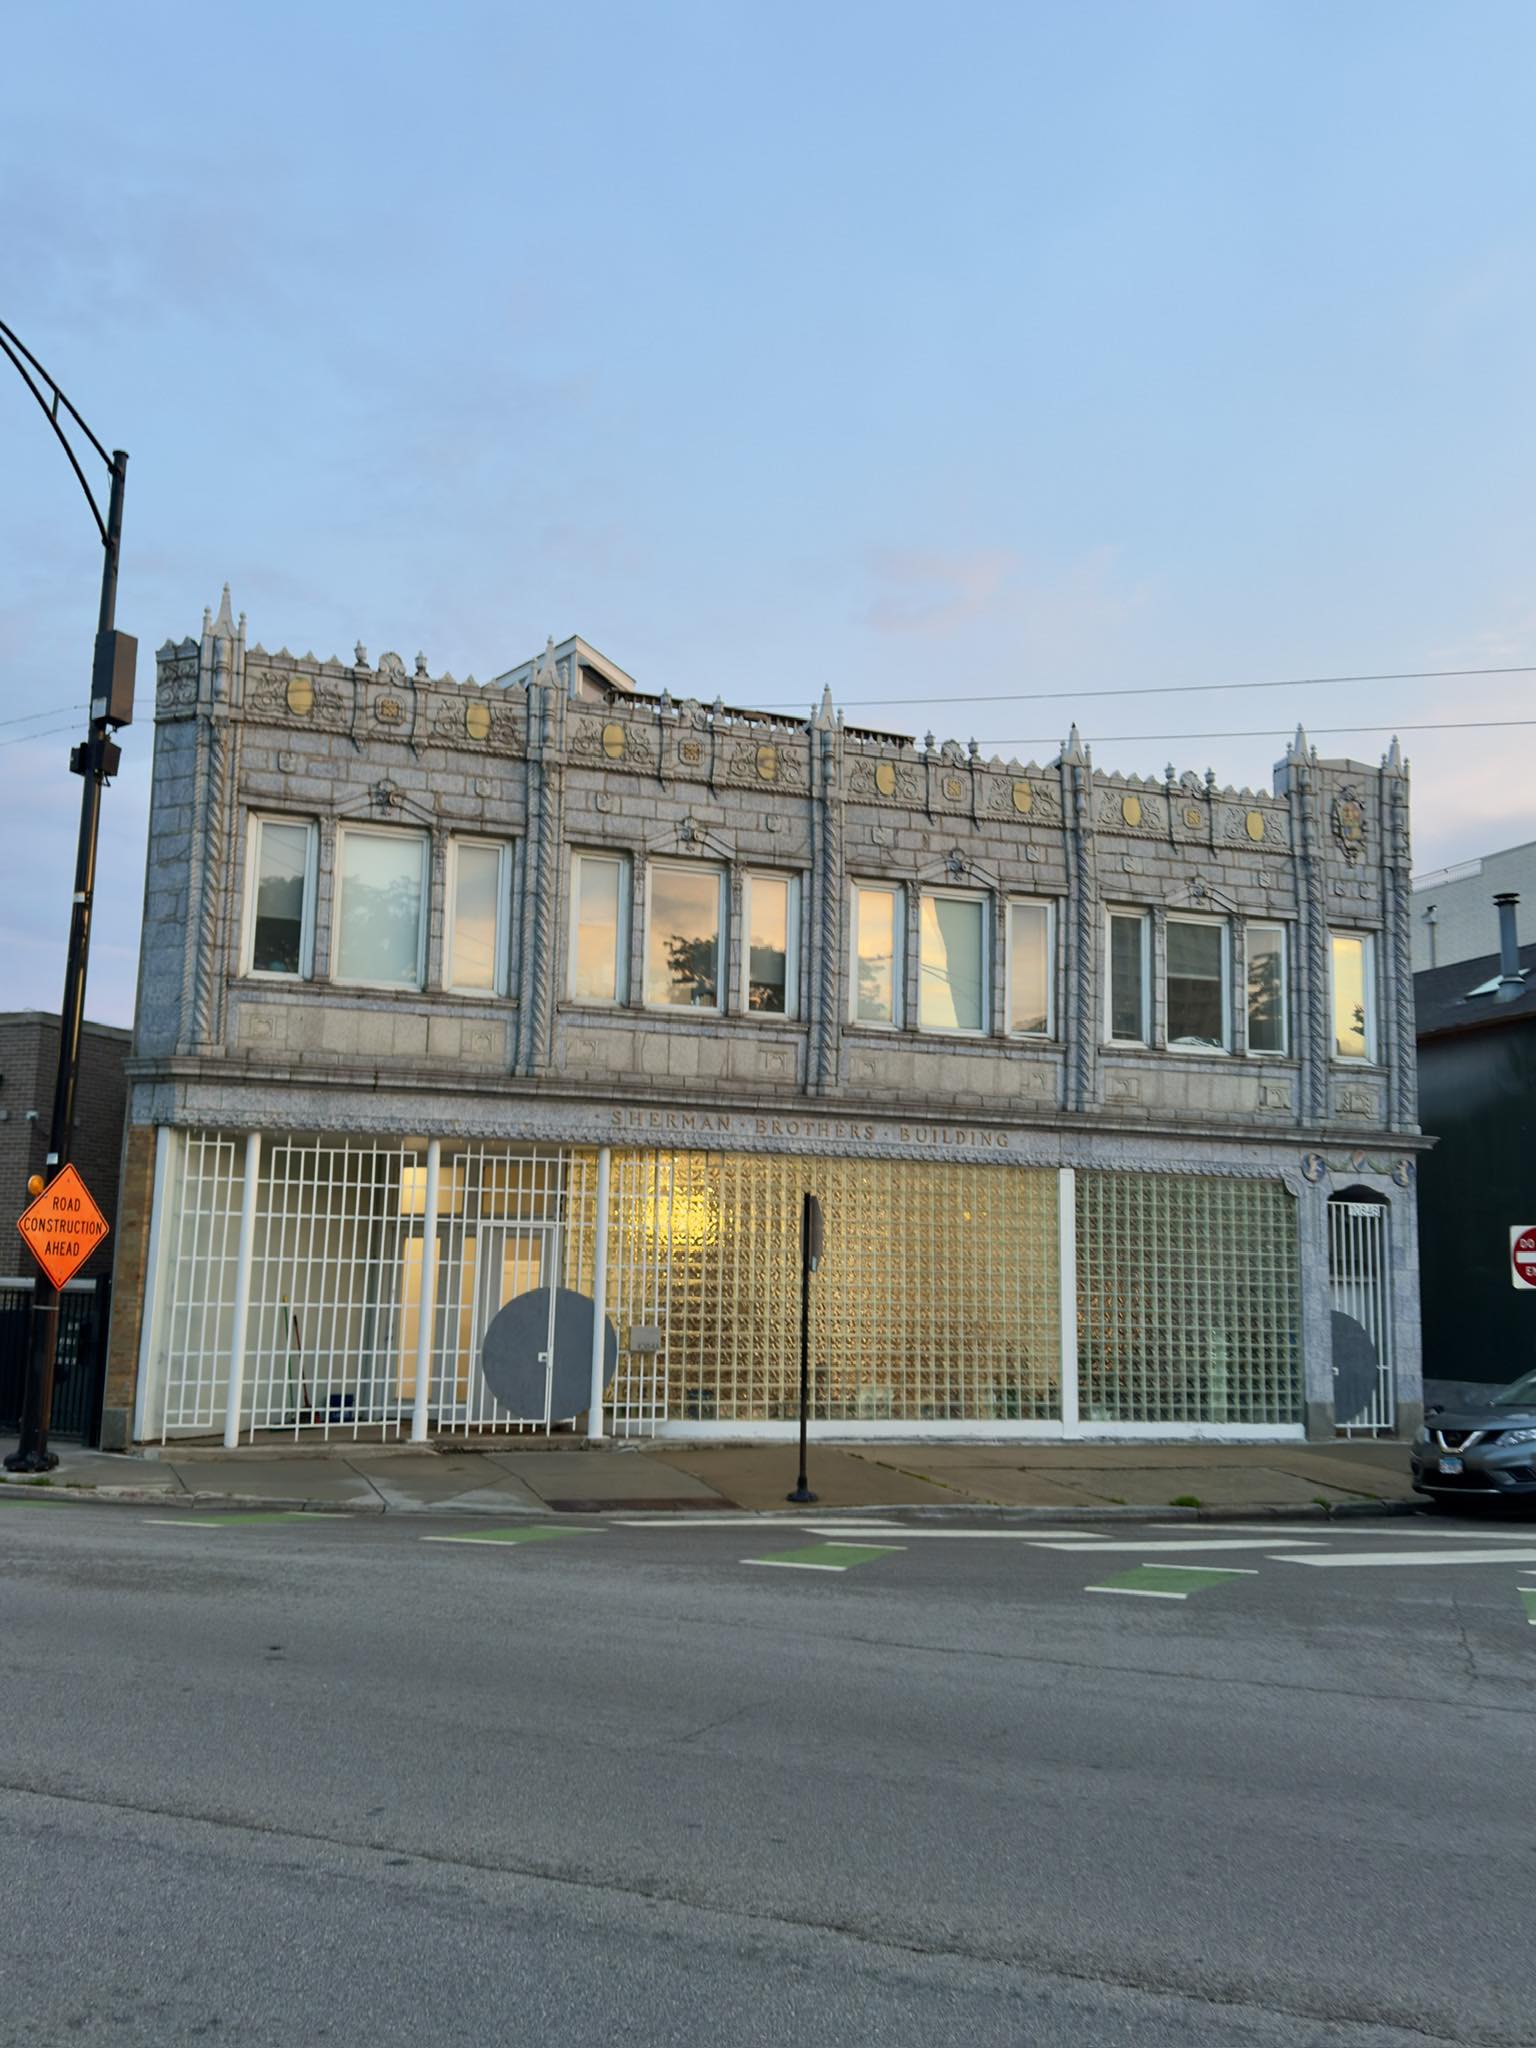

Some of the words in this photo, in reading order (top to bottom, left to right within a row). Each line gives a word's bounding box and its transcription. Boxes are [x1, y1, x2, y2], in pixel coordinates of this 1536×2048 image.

[611, 1110, 731, 1131] SHERMAN
[755, 1118, 875, 1140] BROTHERS
[900, 1127, 1009, 1148] BUILDING
[52, 1196, 81, 1212] ROAD
[23, 1217, 102, 1235] CONSTRUCTION
[44, 1241, 80, 1257] AHEAD
[1519, 1238, 1535, 1249] DO
